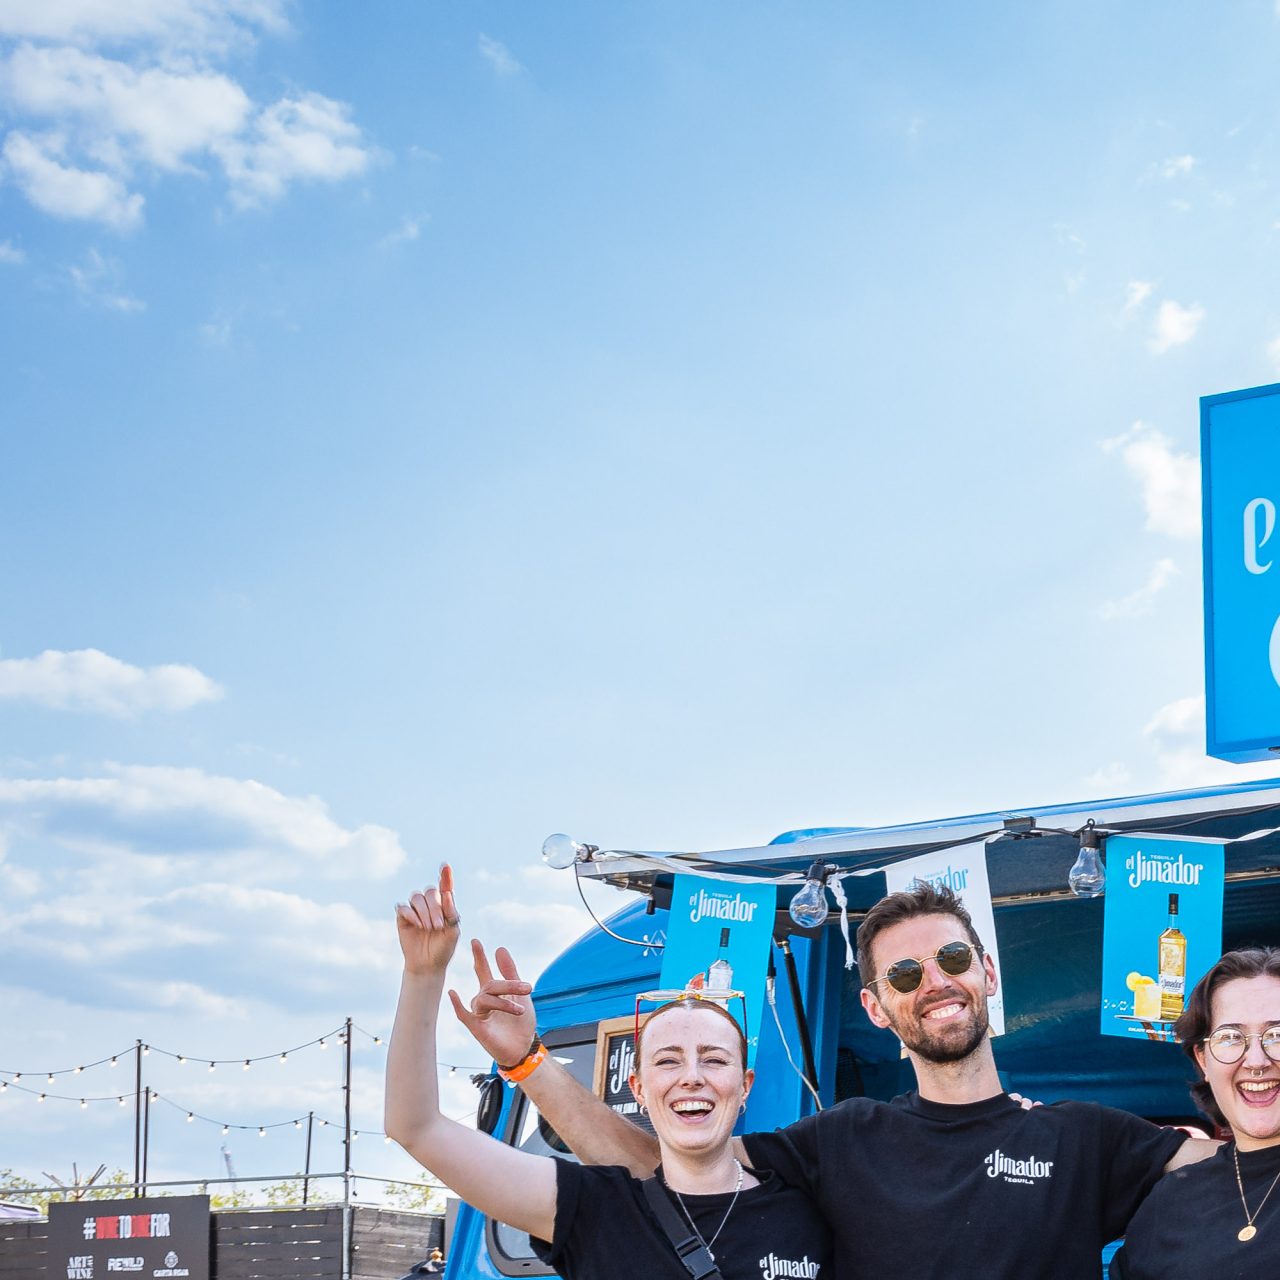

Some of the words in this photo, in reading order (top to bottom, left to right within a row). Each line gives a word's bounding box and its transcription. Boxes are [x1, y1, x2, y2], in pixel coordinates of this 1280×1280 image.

[1126, 856, 1135, 870] el
[1128, 850, 1204, 888] Jimador
[689, 893, 697, 906] el
[690, 888, 758, 922] Jimador
[609, 1048, 619, 1070] el
[987, 1149, 1054, 1178] Jimador
[1003, 1176, 1035, 1185] TEQUILA
[759, 1256, 768, 1269] el
